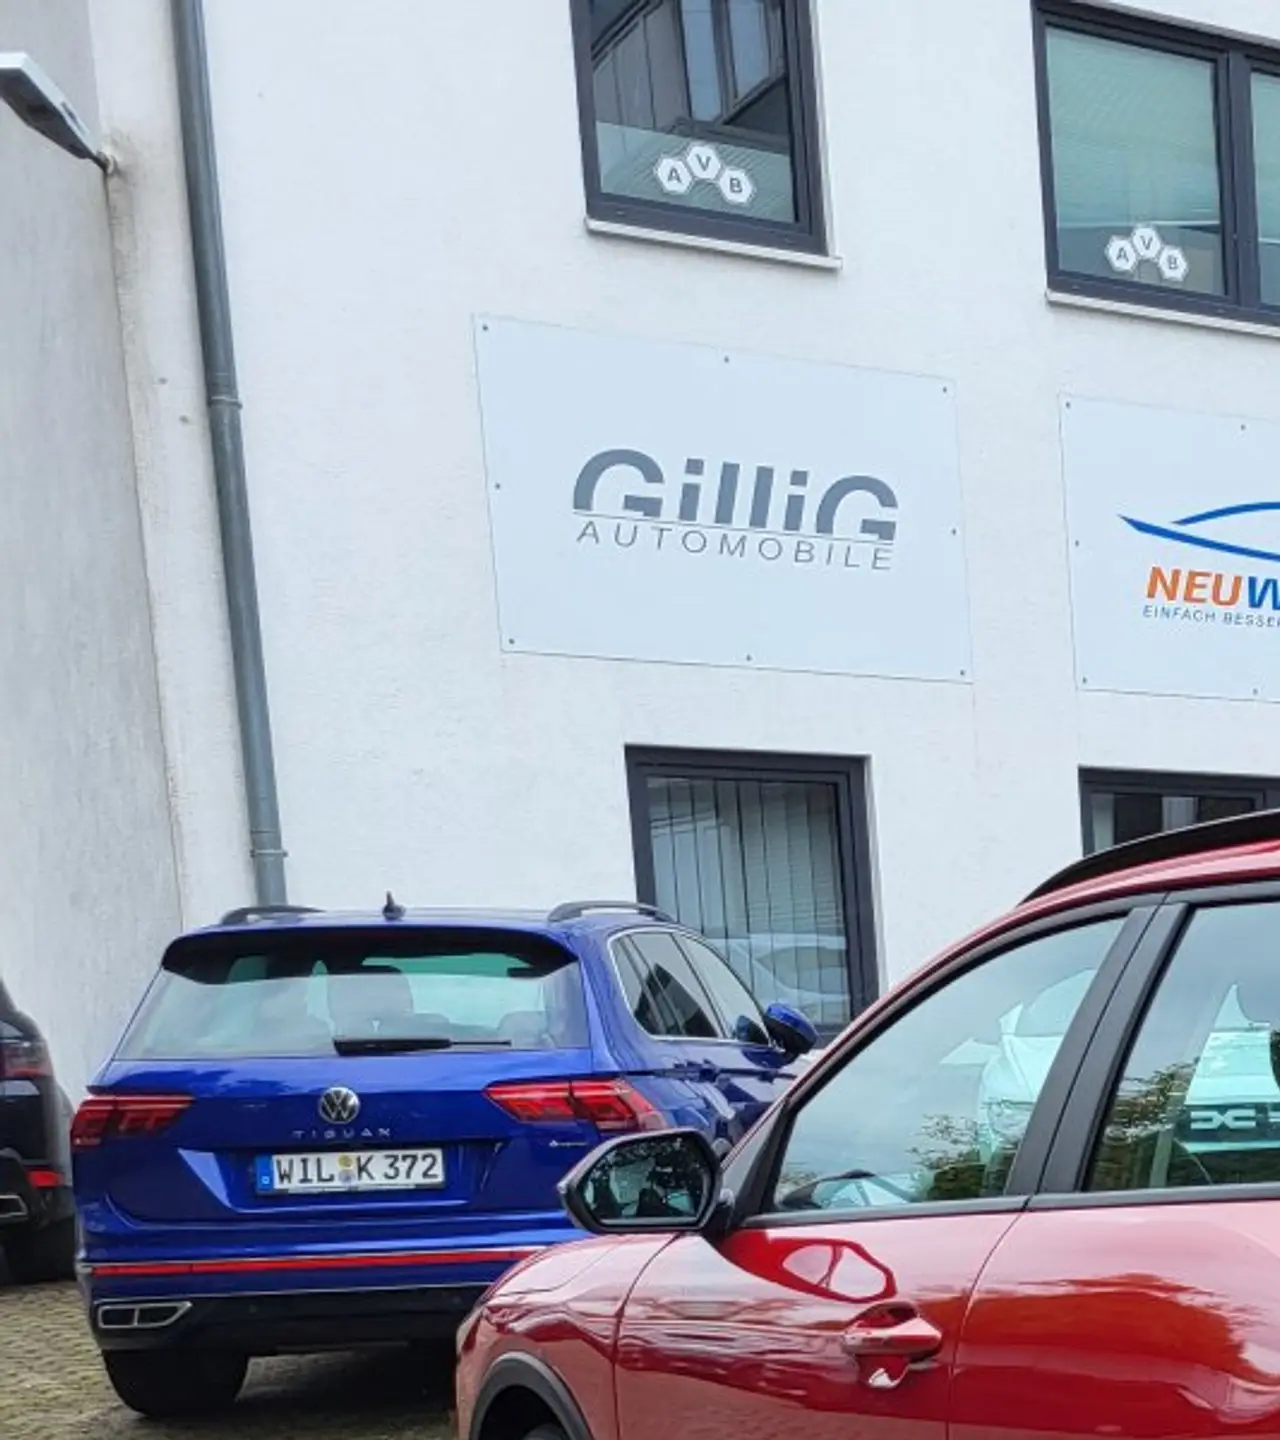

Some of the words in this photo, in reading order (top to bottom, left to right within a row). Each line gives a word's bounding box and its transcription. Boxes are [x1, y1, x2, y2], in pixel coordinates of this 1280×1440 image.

[575, 520, 895, 570] AUTOMOBILE
[1143, 604, 1216, 622] EINFACH
[276, 1156, 336, 1184] WIL
[356, 1154, 375, 1182] K
[383, 1152, 439, 1180] 372
